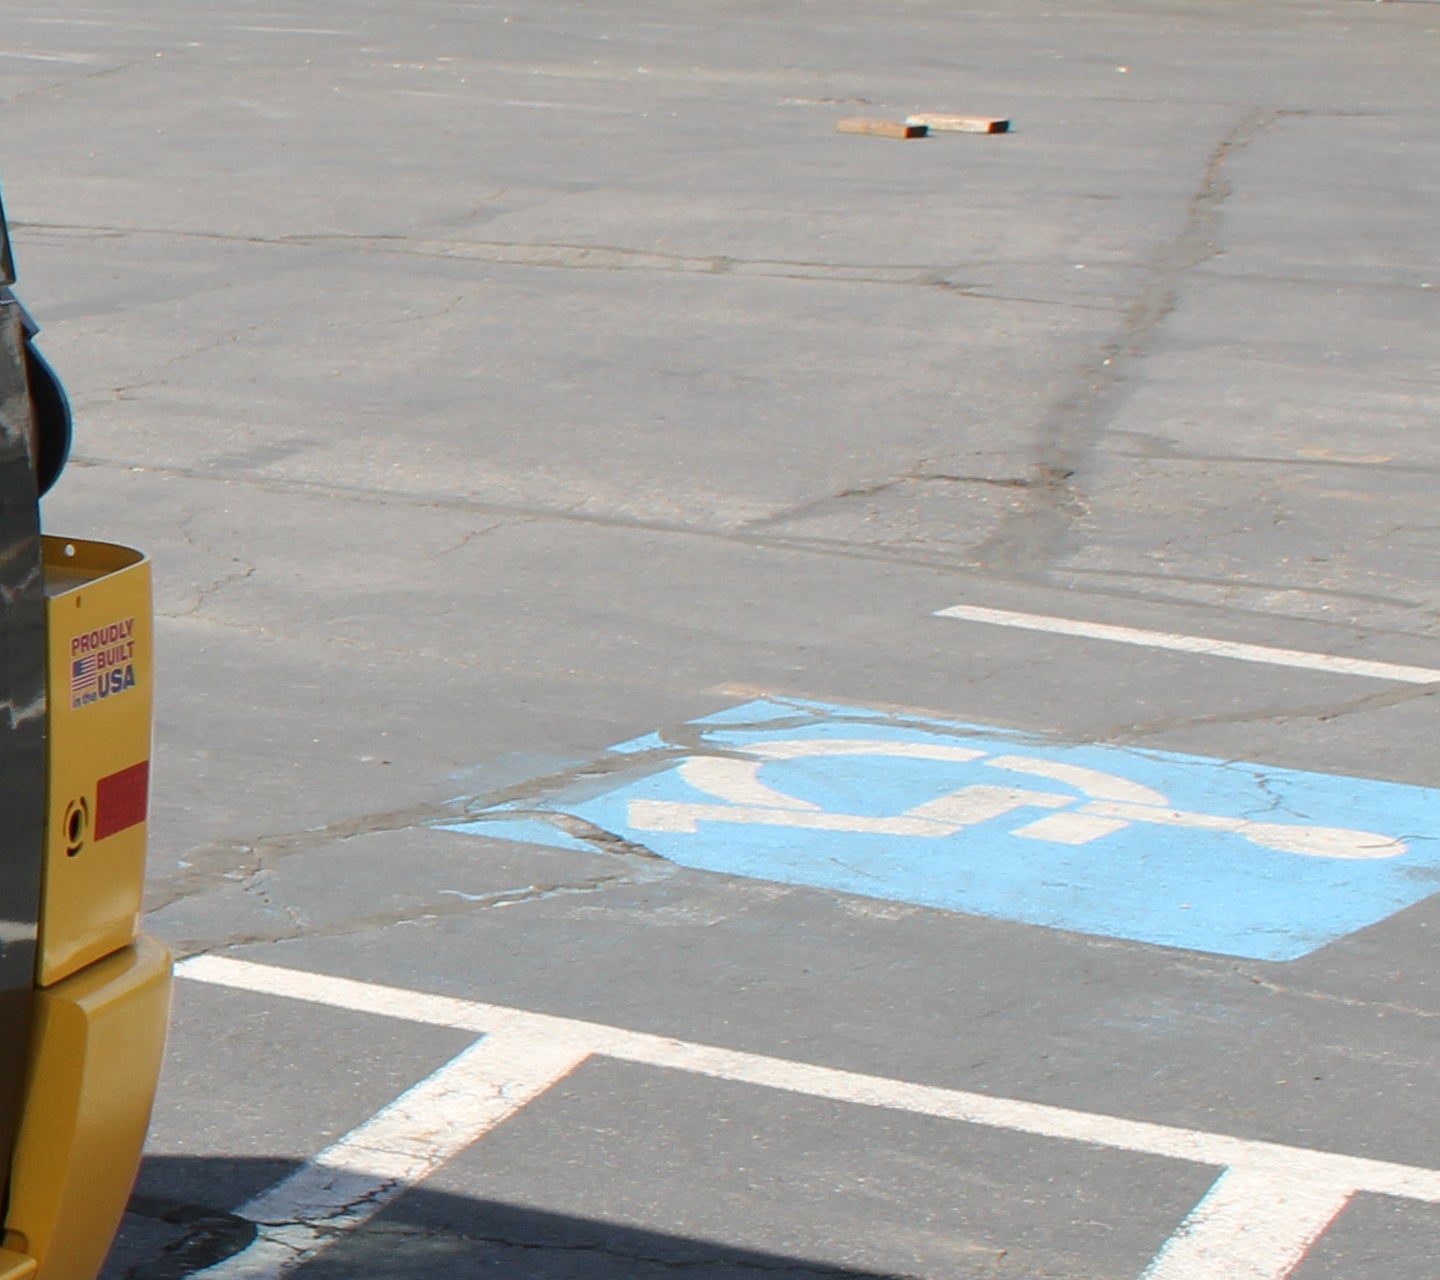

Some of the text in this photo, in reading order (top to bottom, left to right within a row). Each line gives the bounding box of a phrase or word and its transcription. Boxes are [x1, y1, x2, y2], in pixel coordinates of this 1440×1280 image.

[71, 617, 134, 657] PROUDLY
[97, 640, 135, 670] BUILT
[98, 664, 136, 698] USA
